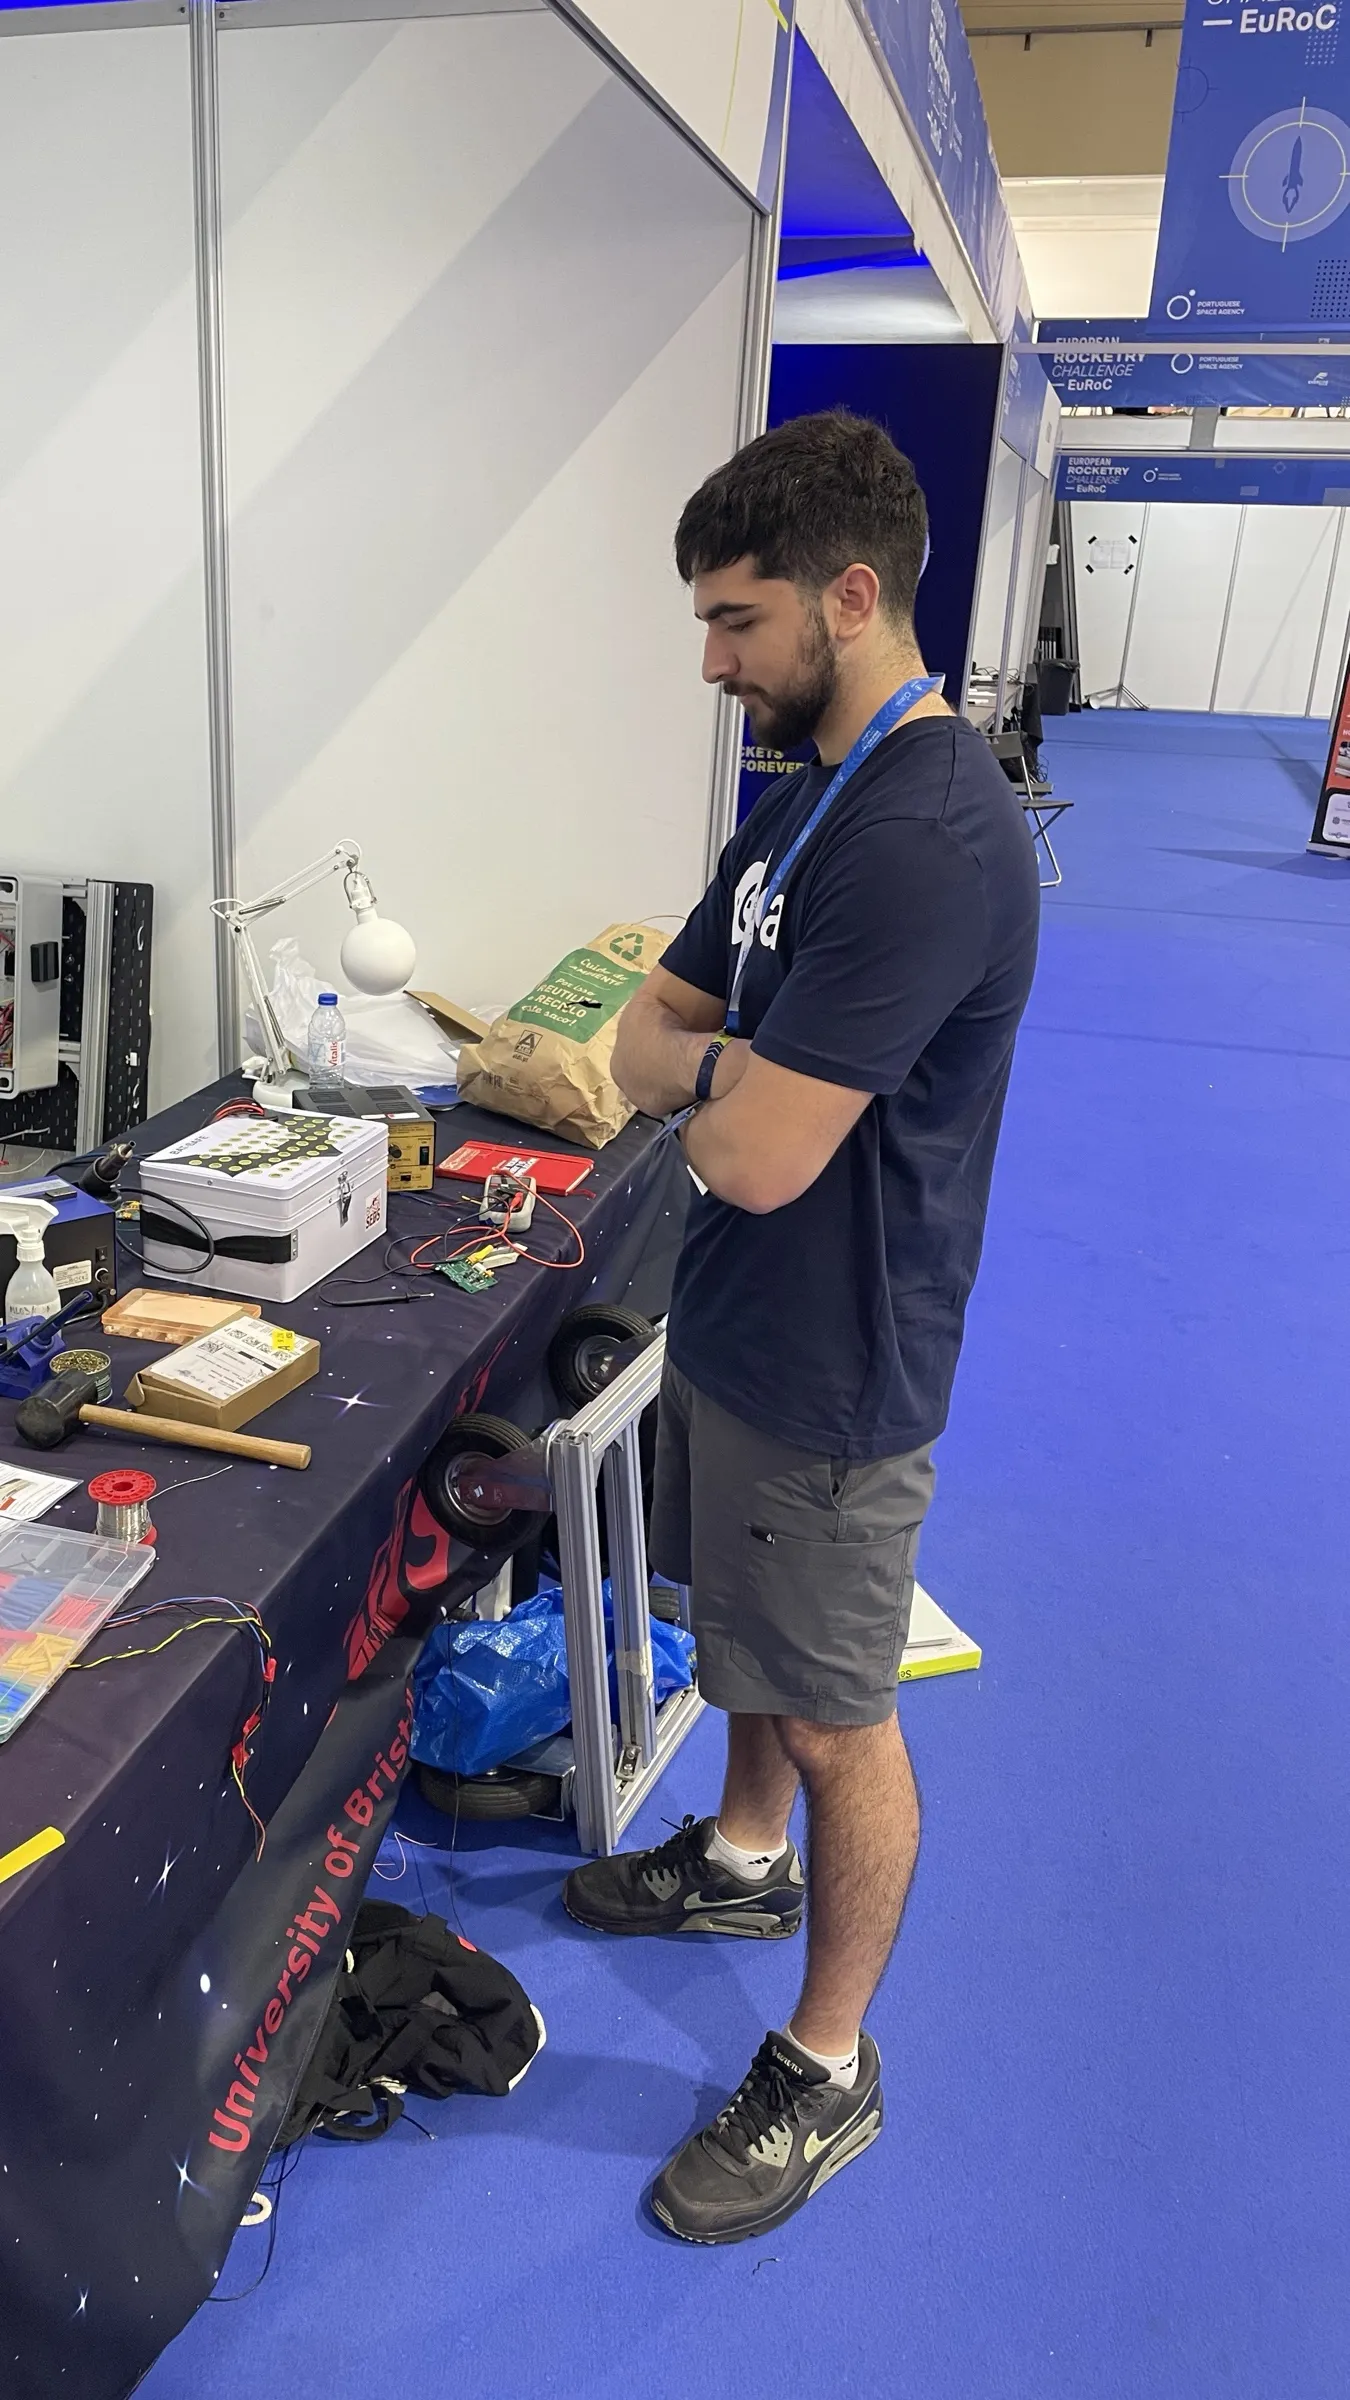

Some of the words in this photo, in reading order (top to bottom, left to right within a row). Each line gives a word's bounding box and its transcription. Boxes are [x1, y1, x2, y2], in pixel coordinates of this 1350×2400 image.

[1240, 4, 1337, 34] EuRoC
[1196, 308, 1217, 316] SPACE
[1051, 363, 1135, 378] CHALLENGE
[1067, 378, 1113, 391] EuRoC
[1068, 457, 1112, 466] EUROPEAN
[1067, 466, 1130, 476] ROCKETRY
[1065, 475, 1121, 485] CHALLENGE
[1076, 484, 1107, 493] EuRoC
[328, 1041, 338, 1067] Vitalis
[208, 1885, 343, 2152] University
[323, 1824, 361, 1878] of
